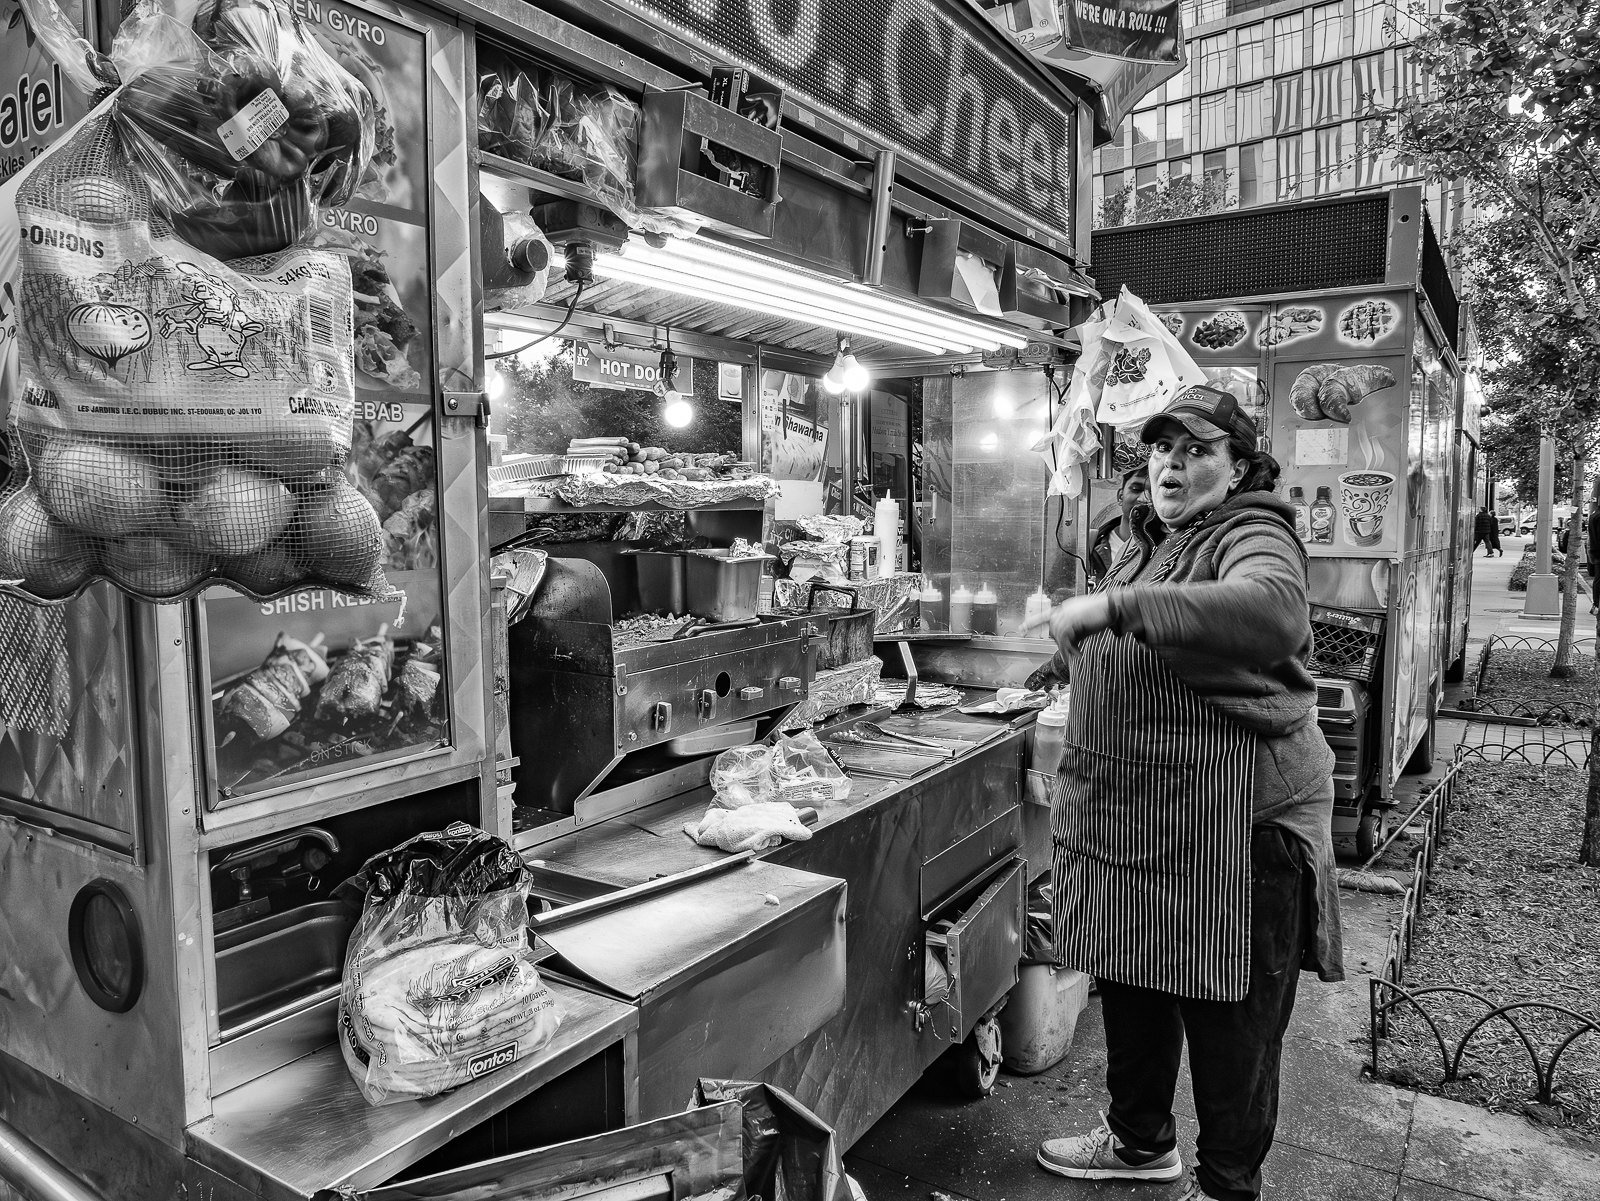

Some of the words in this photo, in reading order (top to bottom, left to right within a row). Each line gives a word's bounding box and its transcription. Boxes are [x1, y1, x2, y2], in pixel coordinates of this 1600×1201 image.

[291, 0, 321, 23] EN
[328, 9, 386, 46] GYRO
[1102, 7, 1117, 27] ON
[1117, 10, 1127, 29] A
[1128, 11, 1154, 31] ROLL
[0, 155, 25, 178] kles
[323, 207, 378, 236] GYRO
[30, 225, 104, 258] ONIONS
[576, 356, 590, 367] NY
[600, 358, 630, 378] HOT
[77, 405, 90, 413] LES
[91, 406, 120, 414] JARDINS
[142, 408, 169, 416] DUBUC
[260, 591, 325, 616] SHISH
[310, 749, 330, 763] ON
[334, 738, 371, 759] STICK
[498, 934, 519, 945] VEGAN
[467, 1044, 518, 1079] kontos
